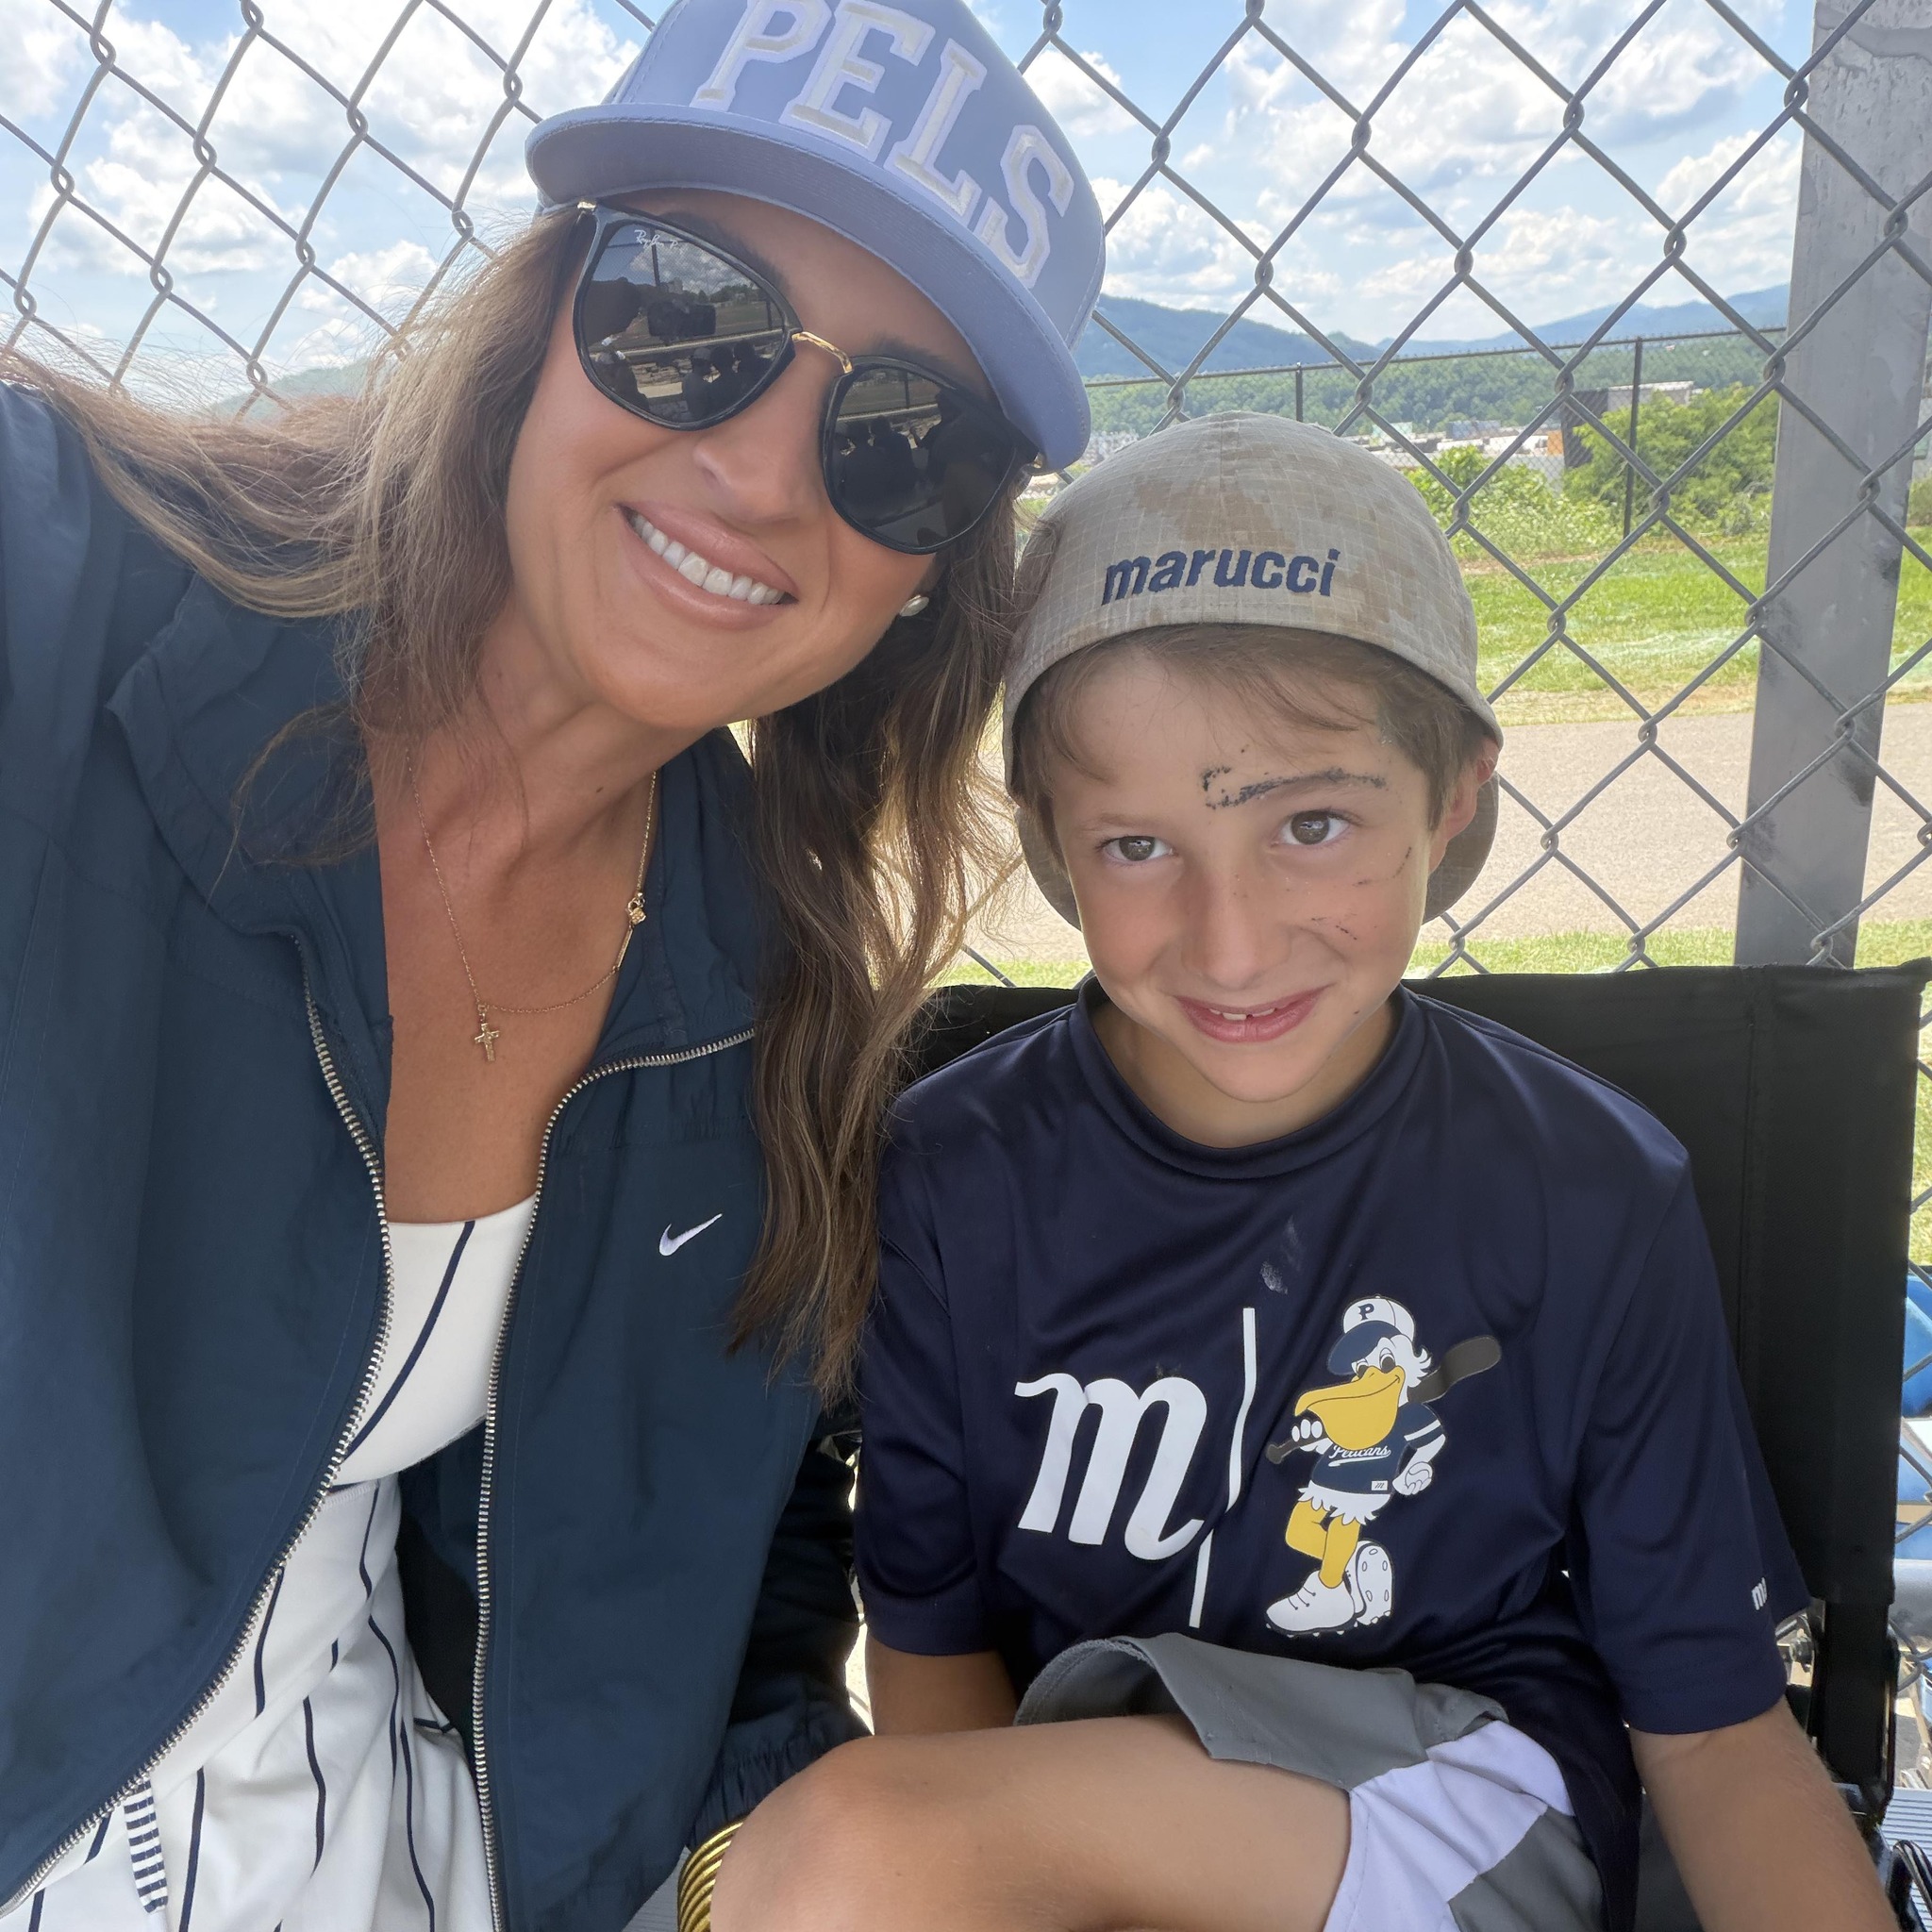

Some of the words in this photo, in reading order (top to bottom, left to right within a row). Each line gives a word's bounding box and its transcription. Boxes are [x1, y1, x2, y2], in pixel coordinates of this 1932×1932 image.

[689, 0, 1074, 289] PELS
[1101, 547, 1341, 606] marucci
[1357, 1303, 1374, 1321] P
